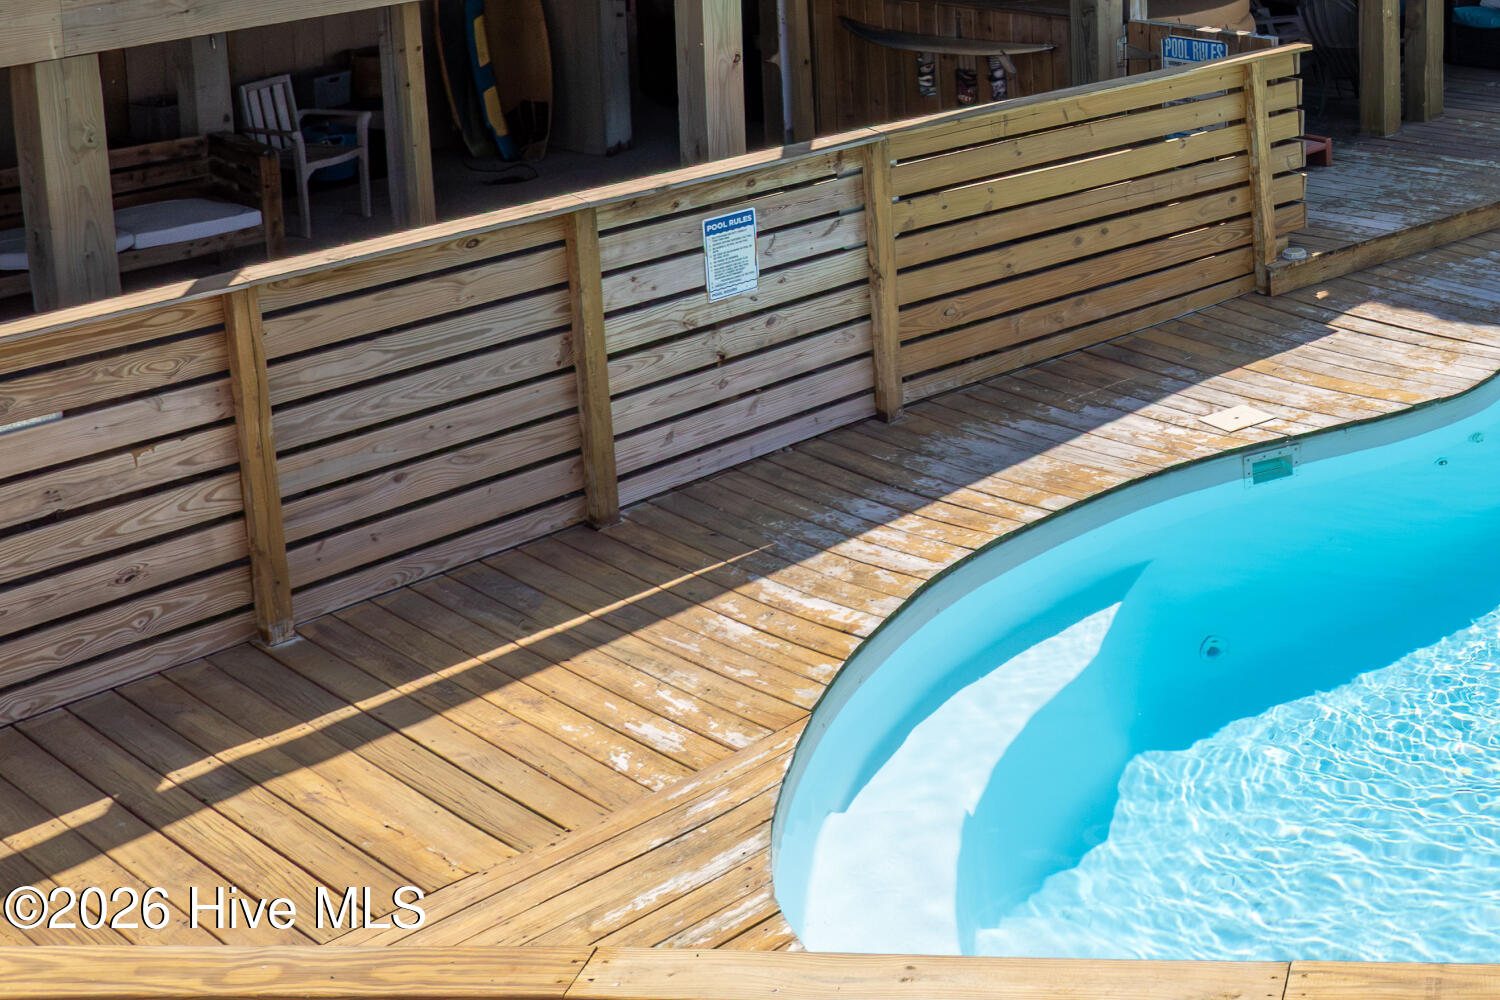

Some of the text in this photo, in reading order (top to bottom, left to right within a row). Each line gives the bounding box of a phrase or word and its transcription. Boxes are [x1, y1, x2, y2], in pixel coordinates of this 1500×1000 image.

[1165, 38, 1223, 61] POOL RULES
[706, 215, 752, 232] POOL RULES
